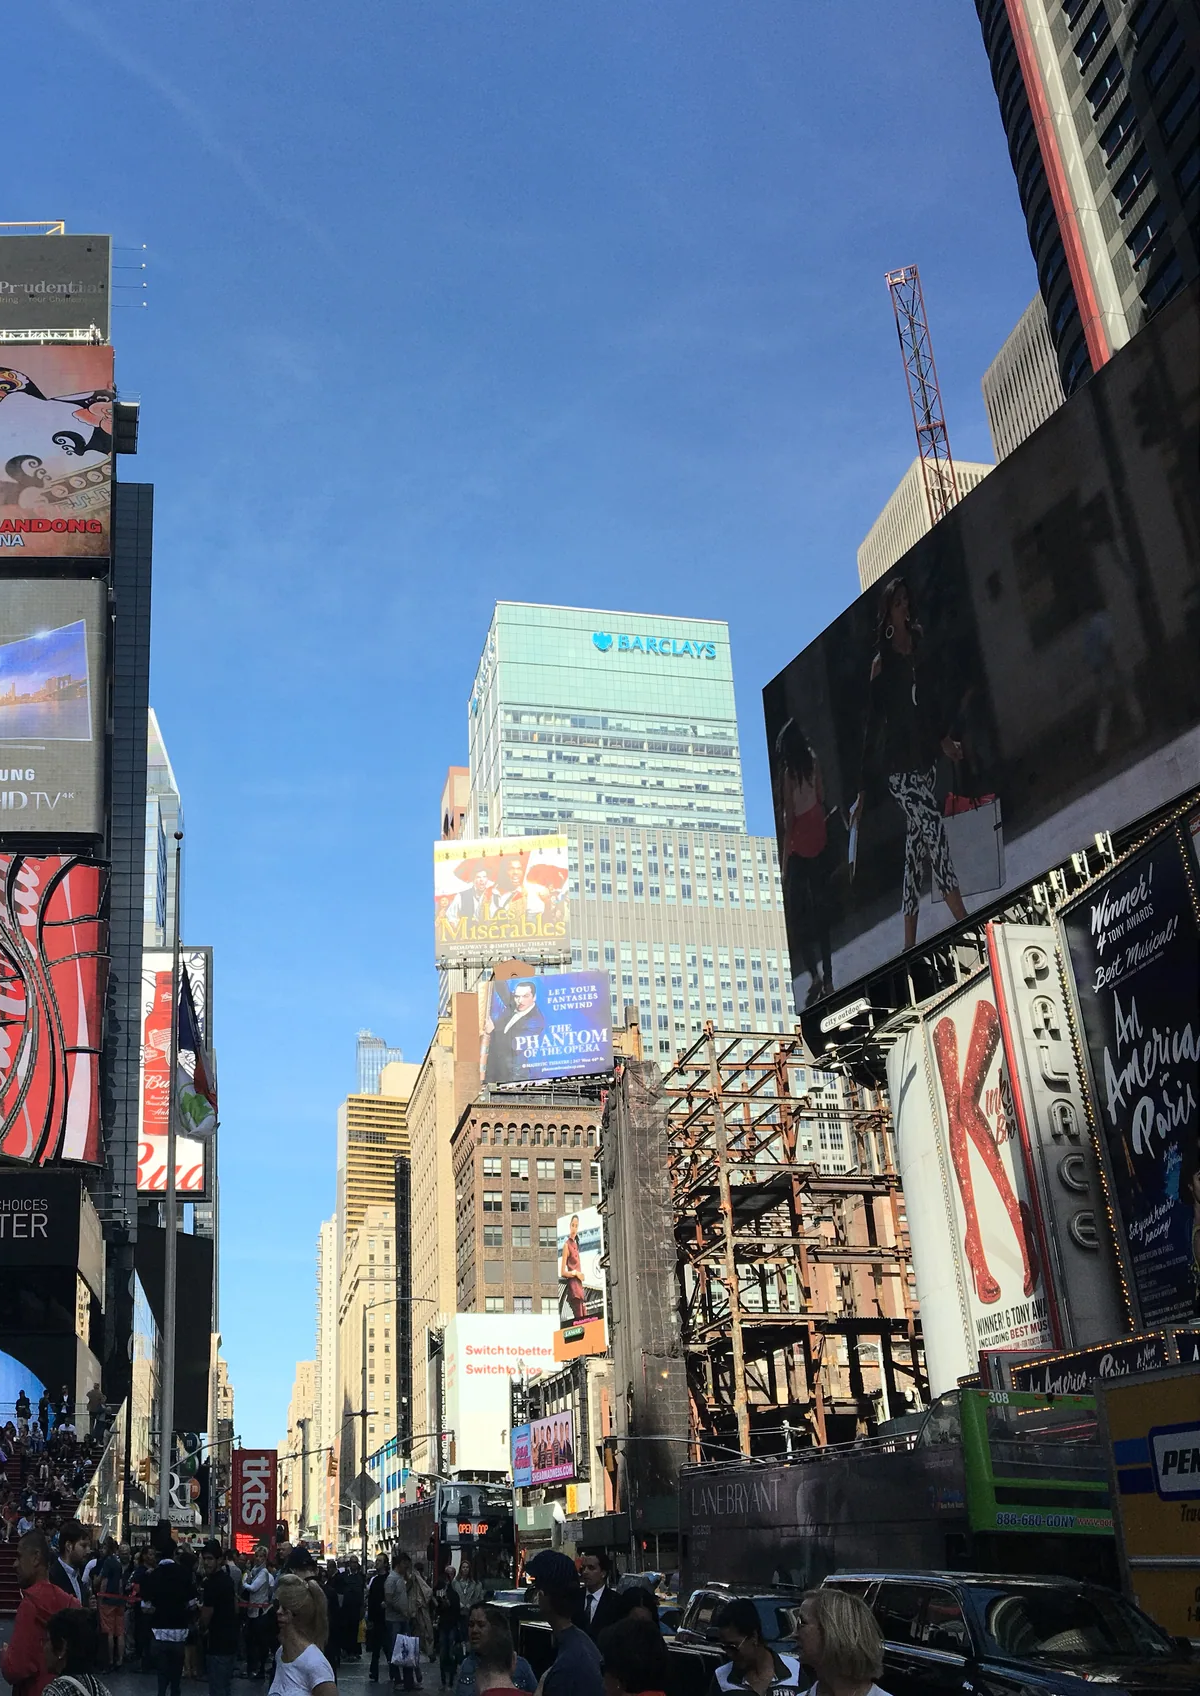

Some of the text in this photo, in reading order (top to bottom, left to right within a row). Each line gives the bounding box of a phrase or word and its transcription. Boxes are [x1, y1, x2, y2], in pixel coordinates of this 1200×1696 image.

[617, 634, 717, 660] BARCLAYS
[1091, 862, 1153, 936] Winner!
[483, 903, 515, 921] Les
[440, 913, 566, 941] Misérables
[1096, 902, 1154, 956] 4 TONY AWARDS
[1092, 953, 1125, 994] Best
[1125, 914, 1178, 968] Musical!
[547, 992, 598, 1004] FANTASIES
[548, 985, 597, 996] LET YOUR
[552, 1001, 593, 1011] UNWIND
[549, 1024, 572, 1034] THE
[824, 1016, 837, 1028] city
[1113, 990, 1143, 1058] An
[515, 1028, 608, 1051] PHANTOM
[523, 1043, 600, 1058] OF THE OPERA
[1103, 1022, 1200, 1125] America
[1159, 1070, 1170, 1087] in
[1019, 944, 1100, 1250] PALACE
[1131, 1079, 1197, 1160] Paris
[975, 1310, 1005, 1337] WINNER!
[1005, 1311, 1011, 1328] 6
[1011, 1304, 1031, 1325] TONY
[978, 1331, 1010, 1349] INCLUDING
[1009, 1325, 1031, 1339] BEST
[465, 1345, 504, 1356] Switch
[507, 1346, 517, 1356] to
[465, 1364, 505, 1375] Switch
[989, 1391, 1010, 1404] 308
[242, 1456, 271, 1525] tkts
[458, 1524, 489, 1535] OPEN LOOP
[996, 1512, 1075, 1528] 888-680-GONY
